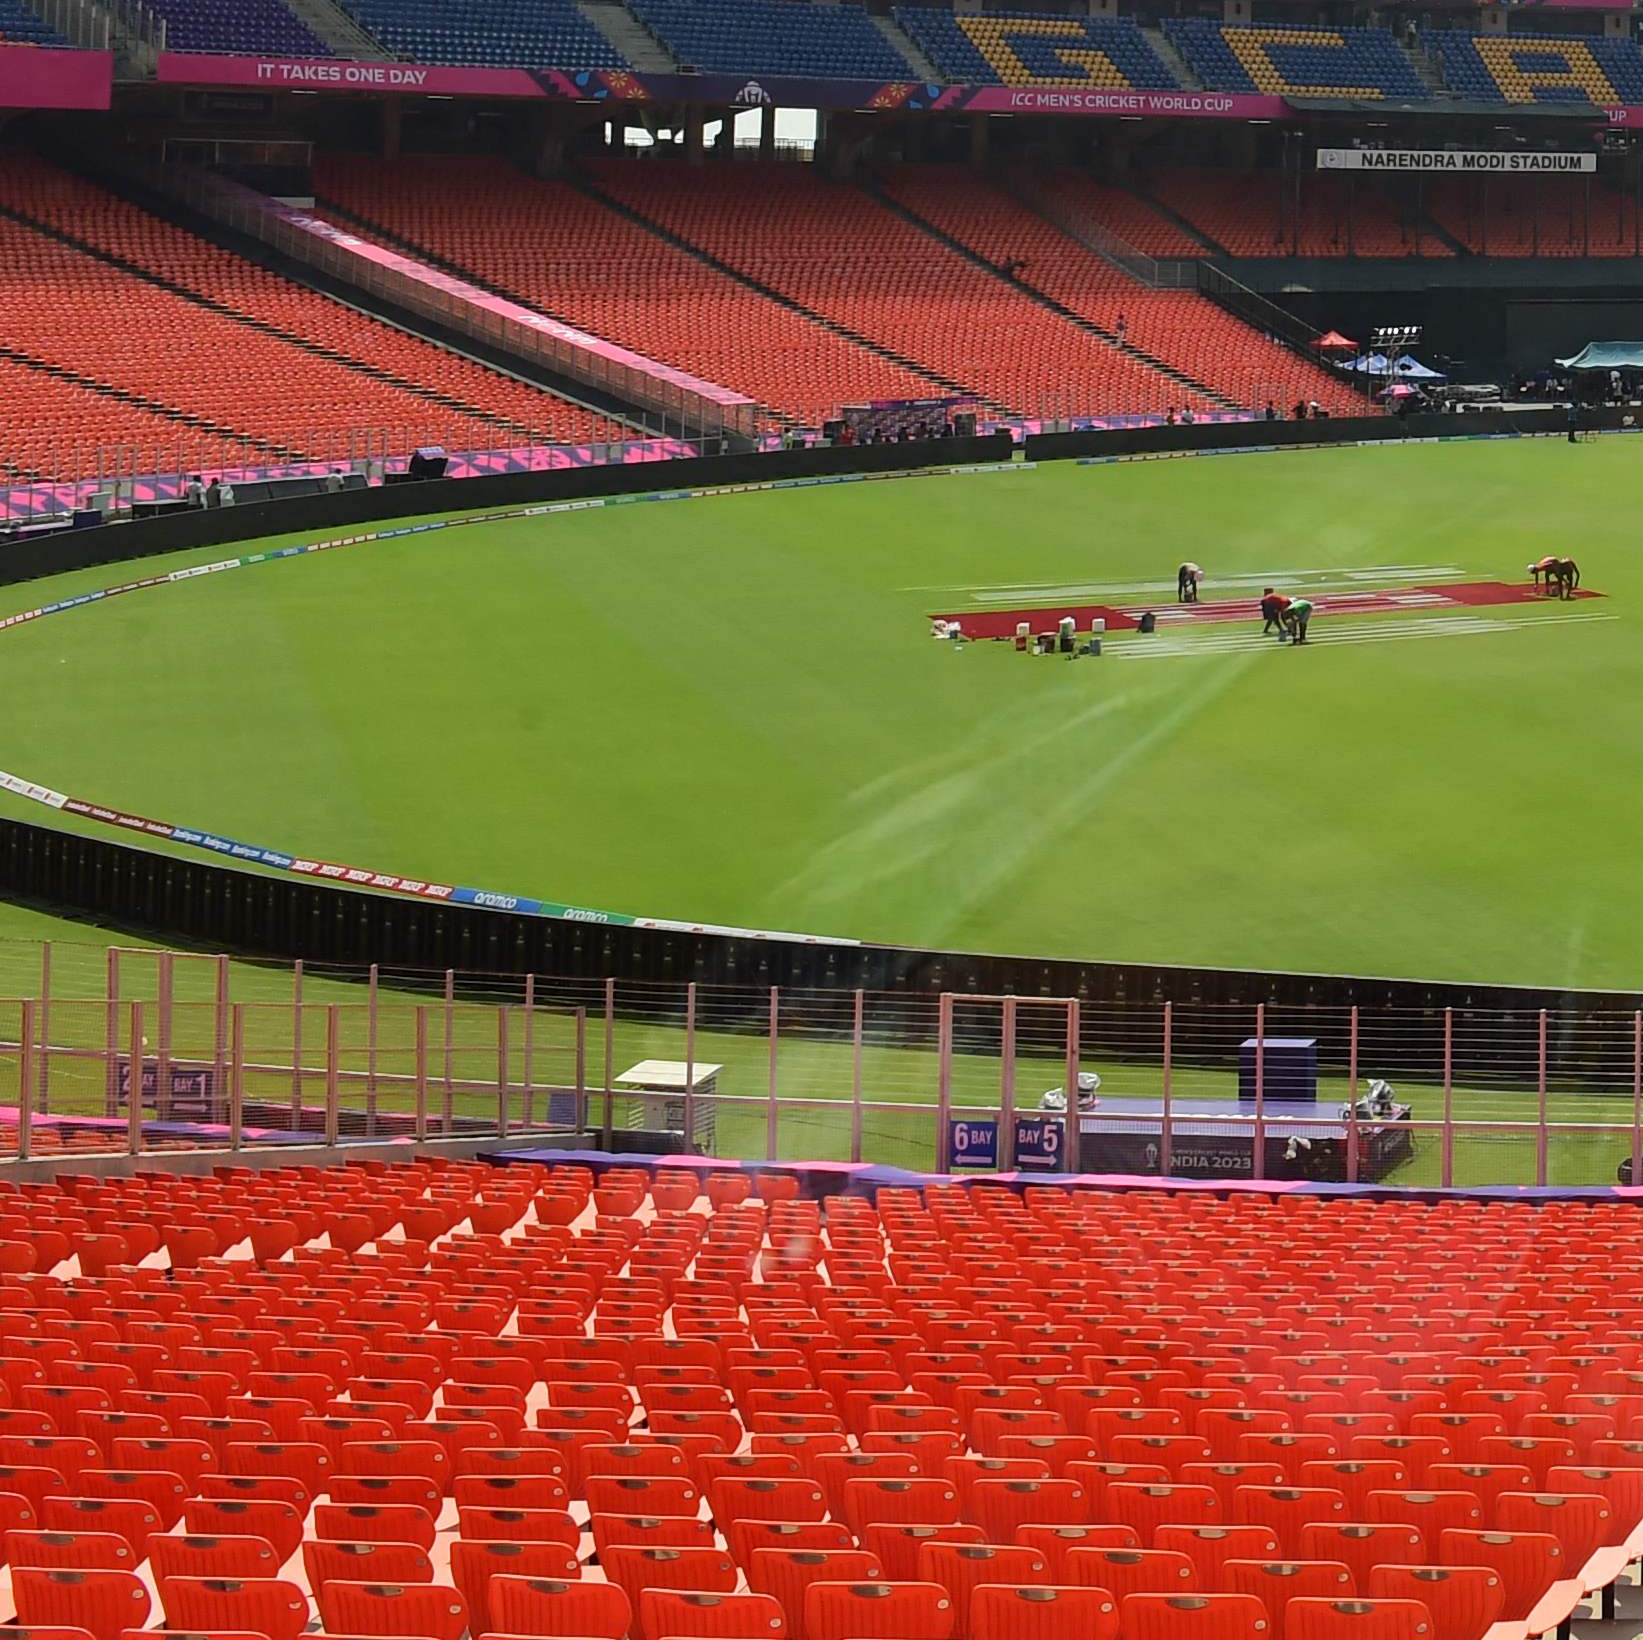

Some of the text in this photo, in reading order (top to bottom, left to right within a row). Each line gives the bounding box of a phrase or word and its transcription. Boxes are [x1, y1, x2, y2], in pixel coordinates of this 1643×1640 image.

[257, 63, 427, 85] IT TAKES ONE DAY
[1011, 93, 1233, 112] ICC MEN'S CRICKET WORLD CUP
[1605, 110, 1627, 122] UP
[1361, 153, 1582, 169] NARENDRA MODI STADIUM
[474, 893, 517, 909] aramco
[195, 1073, 206, 1097] 1
[955, 1123, 992, 1150] 6 BAY
[1019, 1124, 1058, 1152] BAY 5
[1170, 1156, 1252, 1169] NDIA 2023
